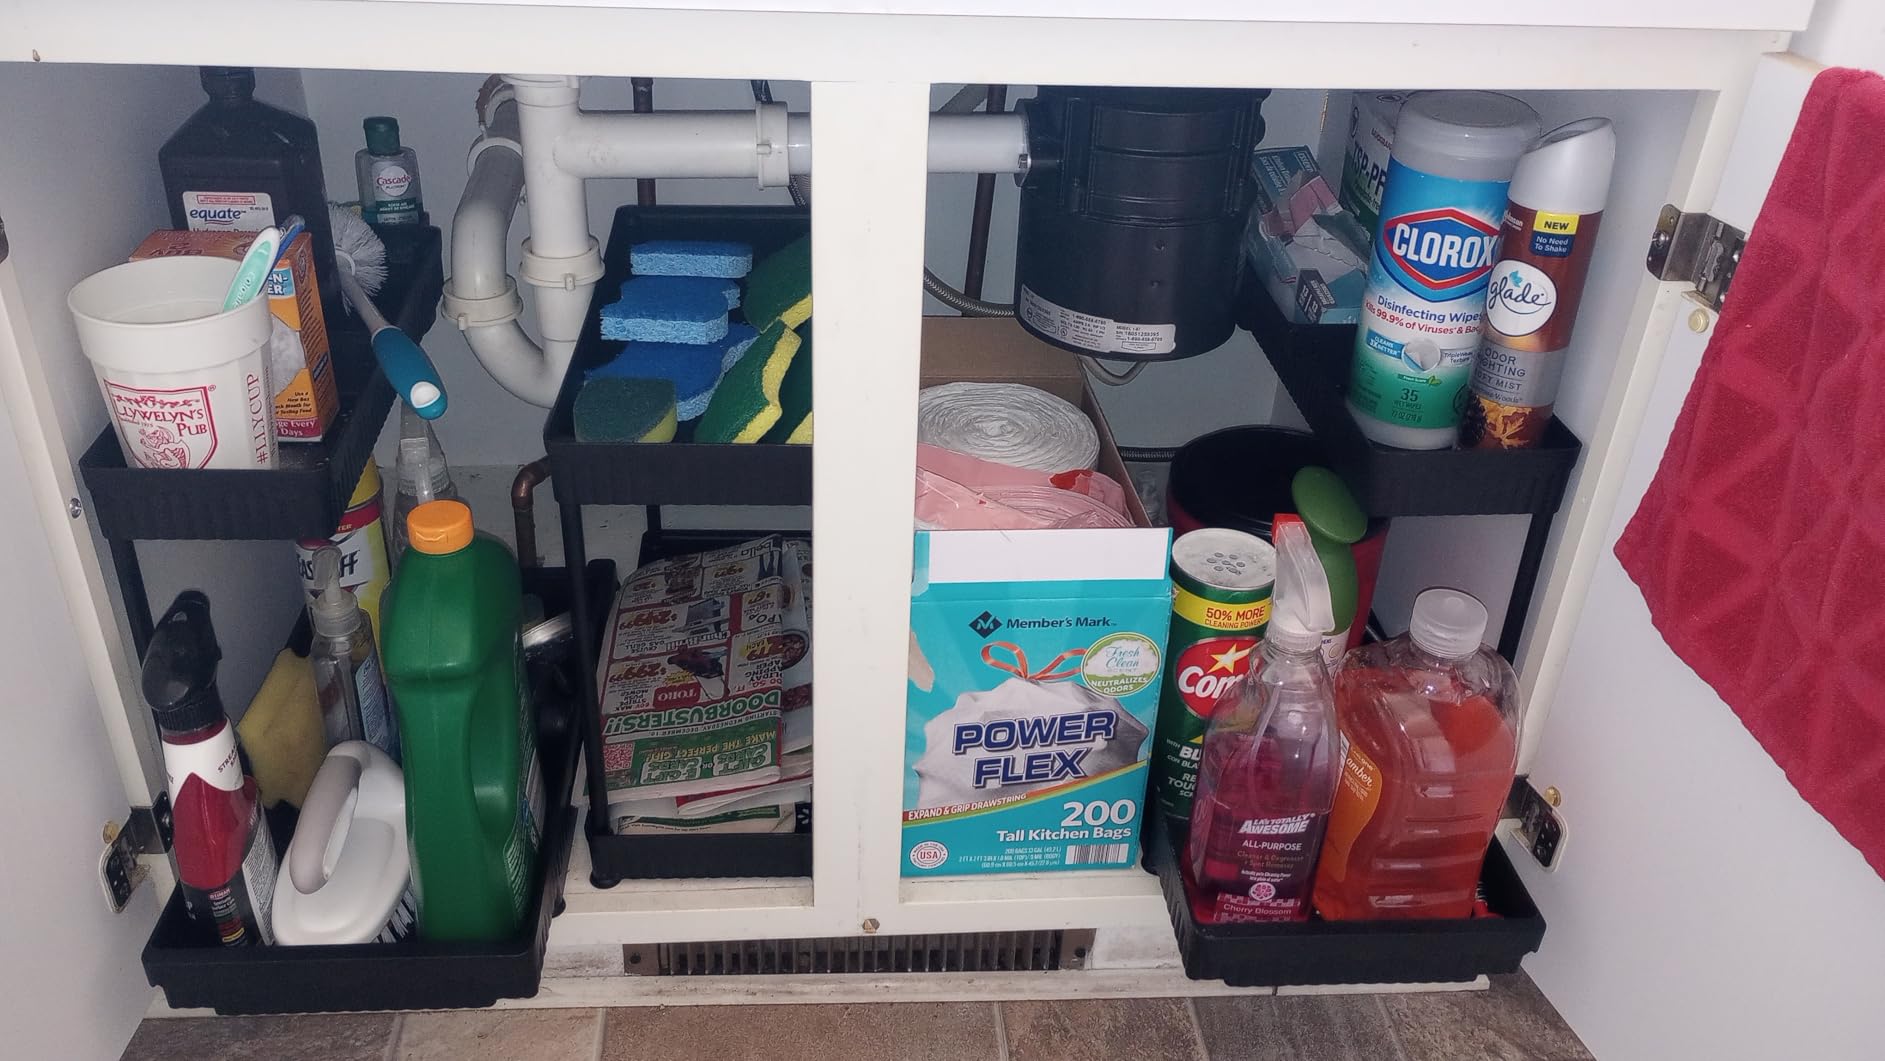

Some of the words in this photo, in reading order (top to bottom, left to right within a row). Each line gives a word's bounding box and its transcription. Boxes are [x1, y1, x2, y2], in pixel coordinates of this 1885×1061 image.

[376, 174, 411, 186] Cascade
[190, 208, 241, 222] equate
[1543, 221, 1570, 231] NEW
[1392, 223, 1498, 268] CLOROX
[1536, 236, 1547, 244] No
[1548, 237, 1569, 246] Need
[1535, 243, 1543, 251] To
[1545, 244, 1568, 253] Shake
[1488, 276, 1552, 310] glade
[1378, 295, 1446, 323] Disinfecting
[1376, 308, 1404, 327] 99.9%
[1405, 321, 1415, 330] of
[1485, 348, 1516, 366] ODOR
[1477, 352, 1526, 378] GHTING
[1496, 380, 1522, 391] MIST
[1401, 388, 1420, 402] 35
[246, 374, 269, 465] #LLYCUP
[291, 420, 316, 428] Every
[281, 428, 303, 436] Days
[1206, 607, 1232, 621] 50%
[1235, 605, 1266, 621] MORE
[1006, 617, 1073, 629] Member's
[1075, 617, 1111, 627] Mark
[1204, 618, 1238, 628] CLEANING
[1105, 646, 1140, 658] Fresh
[756, 660, 783, 669] APER
[1105, 656, 1140, 669] Clean
[744, 666, 783, 678] APPING
[749, 672, 783, 683] OLIDAY
[1090, 677, 1149, 687] NEUTRALIZES
[1178, 665, 1244, 699] Com
[659, 687, 697, 701] TORO
[1103, 684, 1134, 694] ODORS
[606, 692, 779, 735] DOORBUSTERS!!
[745, 710, 777, 721] STARTING
[661, 726, 699, 736] DECEMBER
[745, 731, 775, 744] MAKE
[952, 710, 1118, 754] POWER
[722, 739, 740, 748] THE
[646, 751, 671, 762] GIFT!
[675, 743, 718, 759] PERFECT
[646, 758, 701, 772] CARDS
[719, 756, 766, 776] GIFT
[973, 748, 1089, 788] FLEX
[1346, 757, 1373, 787] amber
[908, 809, 943, 821] EXPAND
[943, 808, 951, 817] &
[951, 804, 971, 814] GRIP
[971, 793, 1027, 811] DRAWSTRING
[1061, 799, 1137, 827] 200
[1237, 819, 1311, 834] AWESOME
[997, 830, 1025, 842] Tall
[1028, 827, 1090, 841] Kitchen
[1093, 827, 1132, 840] Bags
[1241, 840, 1303, 850] ALL-PURPOSE
[919, 851, 938, 860] USA
[1223, 903, 1253, 914] Cherry
[1255, 907, 1292, 915] Blossom
